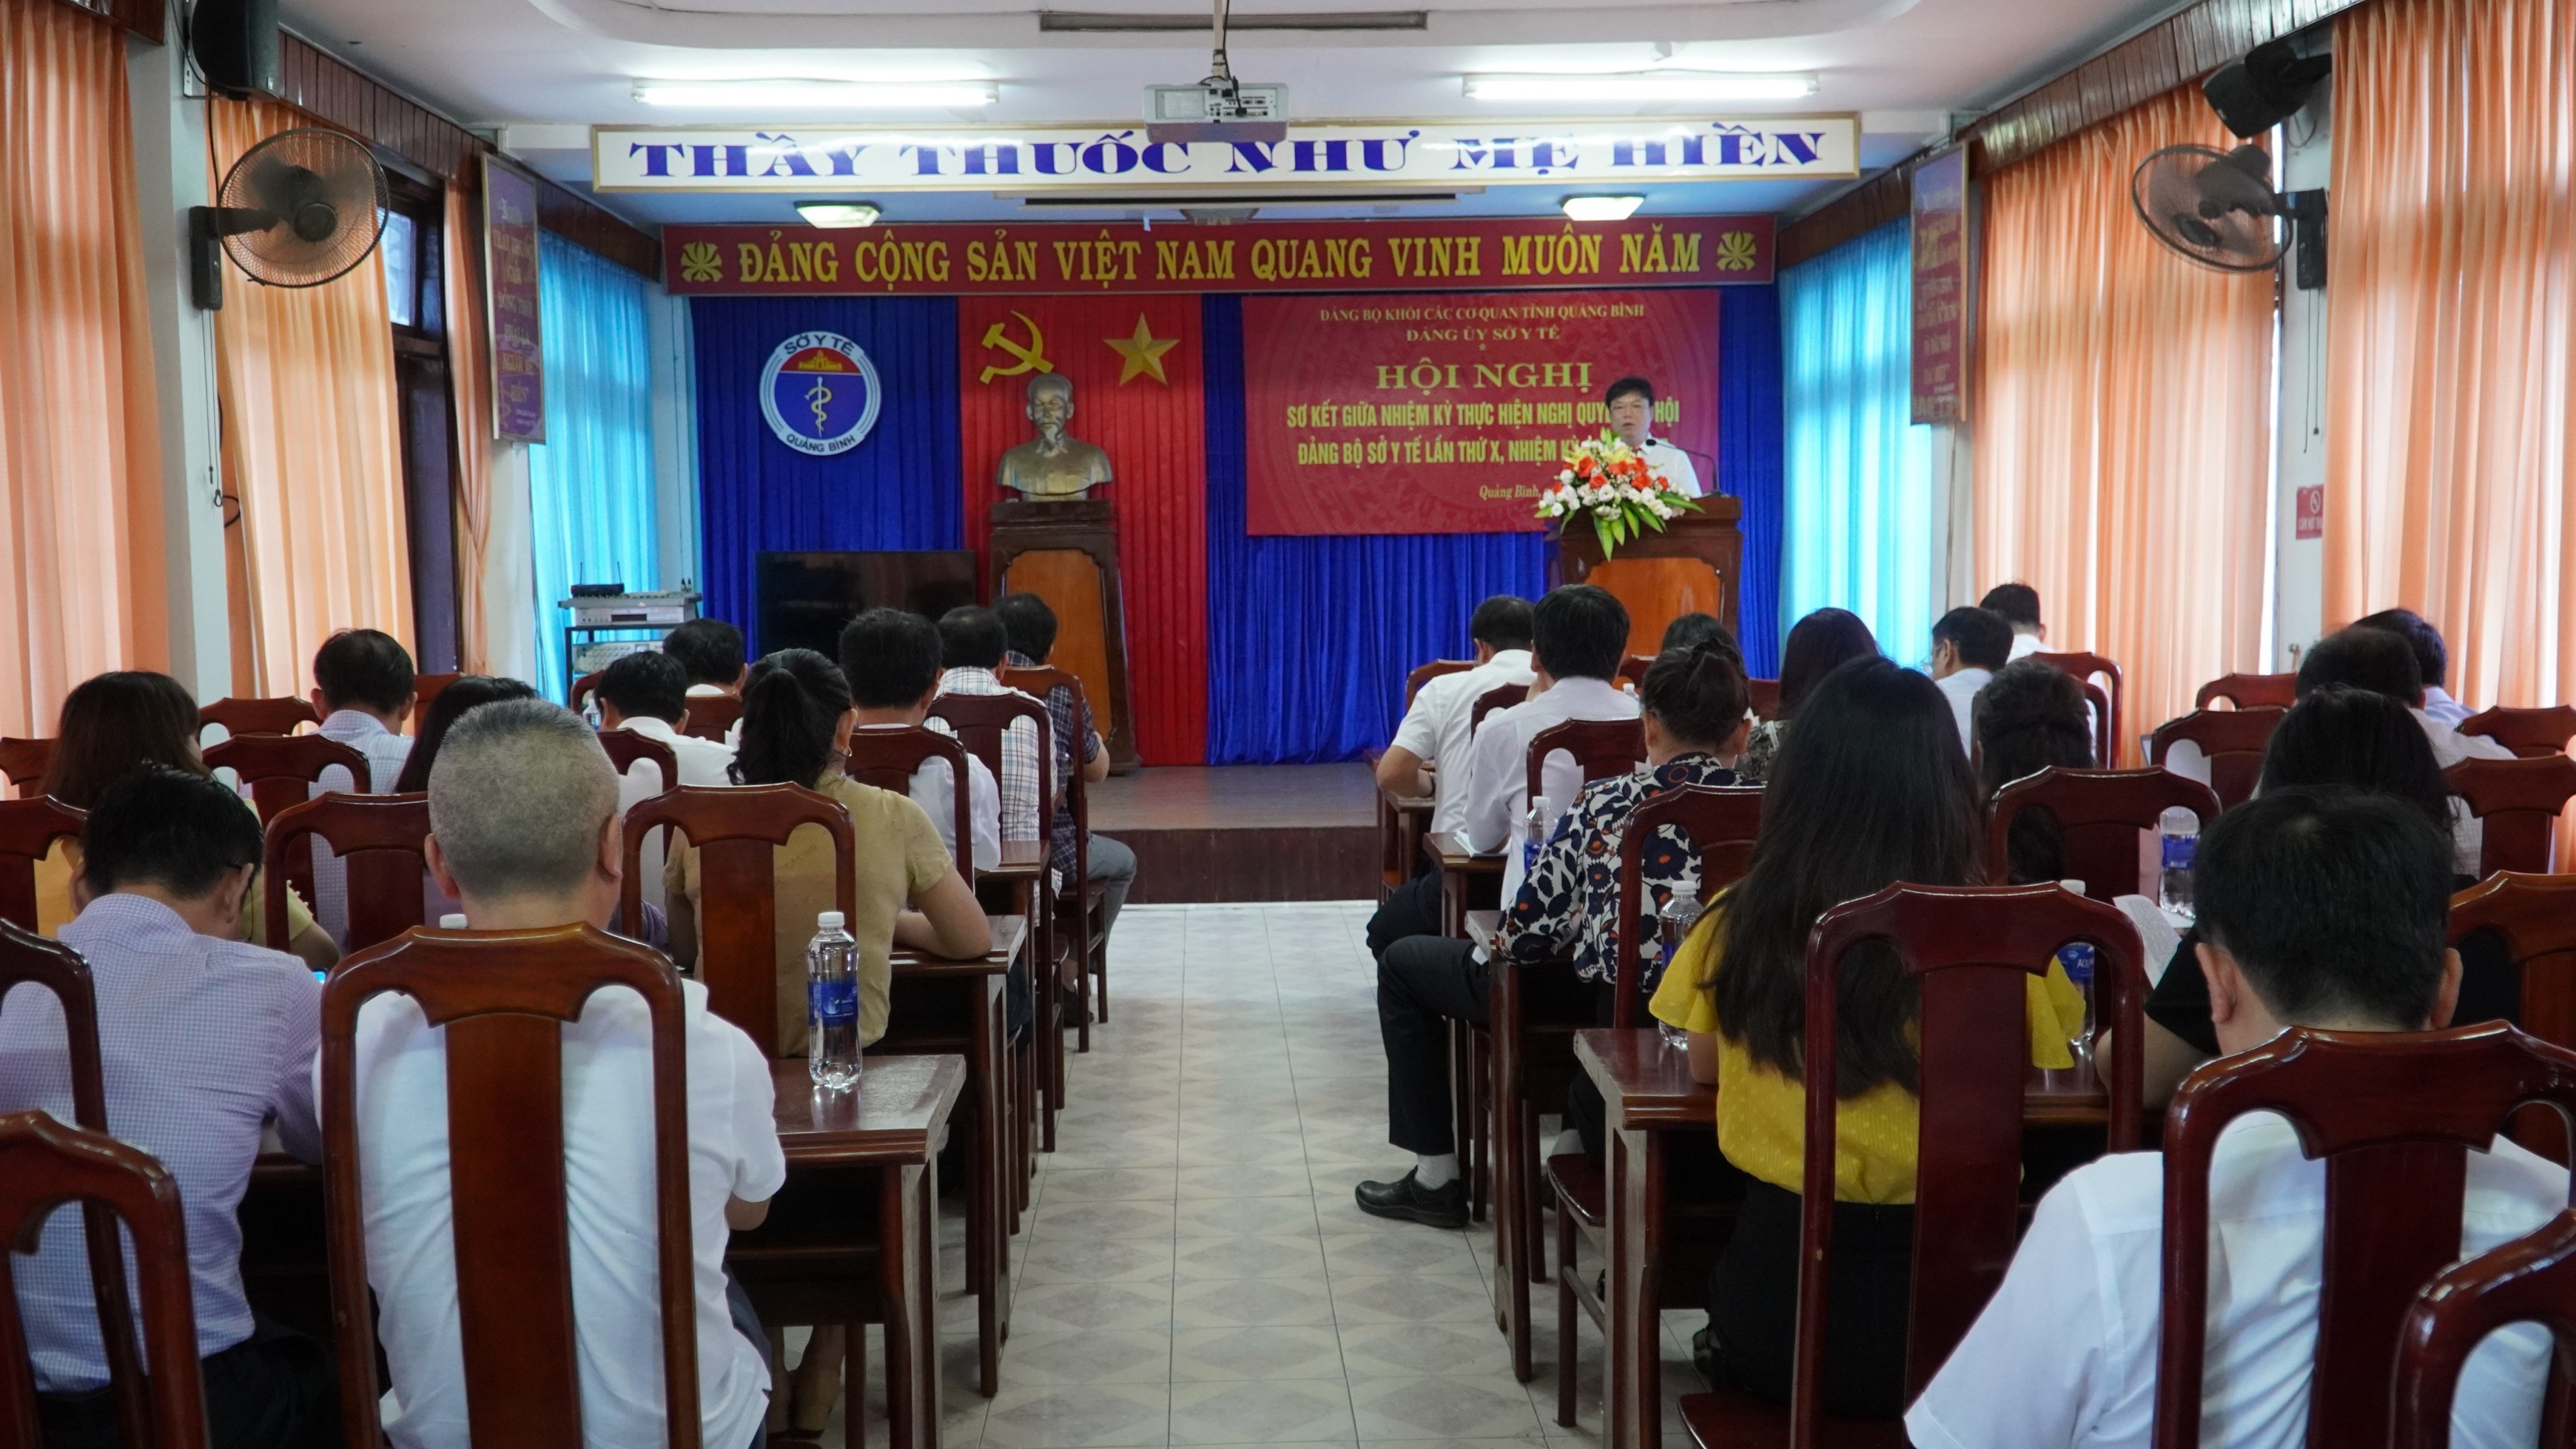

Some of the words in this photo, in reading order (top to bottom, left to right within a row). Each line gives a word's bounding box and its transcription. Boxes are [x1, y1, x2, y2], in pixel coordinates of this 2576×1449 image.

[630, 131, 872, 176] THẦY
[900, 130, 1191, 175] THUỐC
[1224, 130, 1420, 173] NHƯ
[1449, 133, 1579, 175] MẸ
[1608, 122, 1826, 167] HIỀN
[737, 230, 839, 282] ĐẢNG
[855, 229, 951, 291] CỘNG
[967, 229, 1037, 282] SẢN
[1053, 229, 1142, 289] VIỆT
[1156, 240, 1235, 280] NAM
[1251, 238, 1373, 282] QUANG
[1388, 236, 1481, 277] VINH
[1501, 222, 1603, 275] MUÔN
[1619, 223, 1702, 273] NĂM
[1424, 306, 1454, 321] CÁC
[1479, 306, 1518, 322] QUAN
[814, 334, 827, 346] Y
[1520, 327, 1533, 340] Y
[1376, 357, 1461, 396] HỘI
[1473, 362, 1593, 394] NGHỊ
[1287, 403, 1308, 428] SƠ
[1311, 398, 1338, 428] KẾT
[1342, 400, 1378, 427] GIỮA
[1381, 399, 1430, 431] NHIỆM
[1434, 399, 1452, 426] KỲ
[1456, 401, 1495, 430] THỰC
[1498, 398, 1533, 430] HIỆN
[1537, 401, 1573, 429] NGHỊ
[1654, 396, 1680, 428] HỘI
[1298, 435, 1339, 465] ĐẢNG
[1343, 438, 1363, 469] BỘ
[1367, 435, 1388, 464] SỞ
[1391, 441, 1400, 463] Y
[1404, 434, 1422, 464] TẾ
[1458, 436, 1488, 463] THỨ
[1490, 440, 1505, 465] X,
[1508, 435, 1557, 466] NHIỆM
